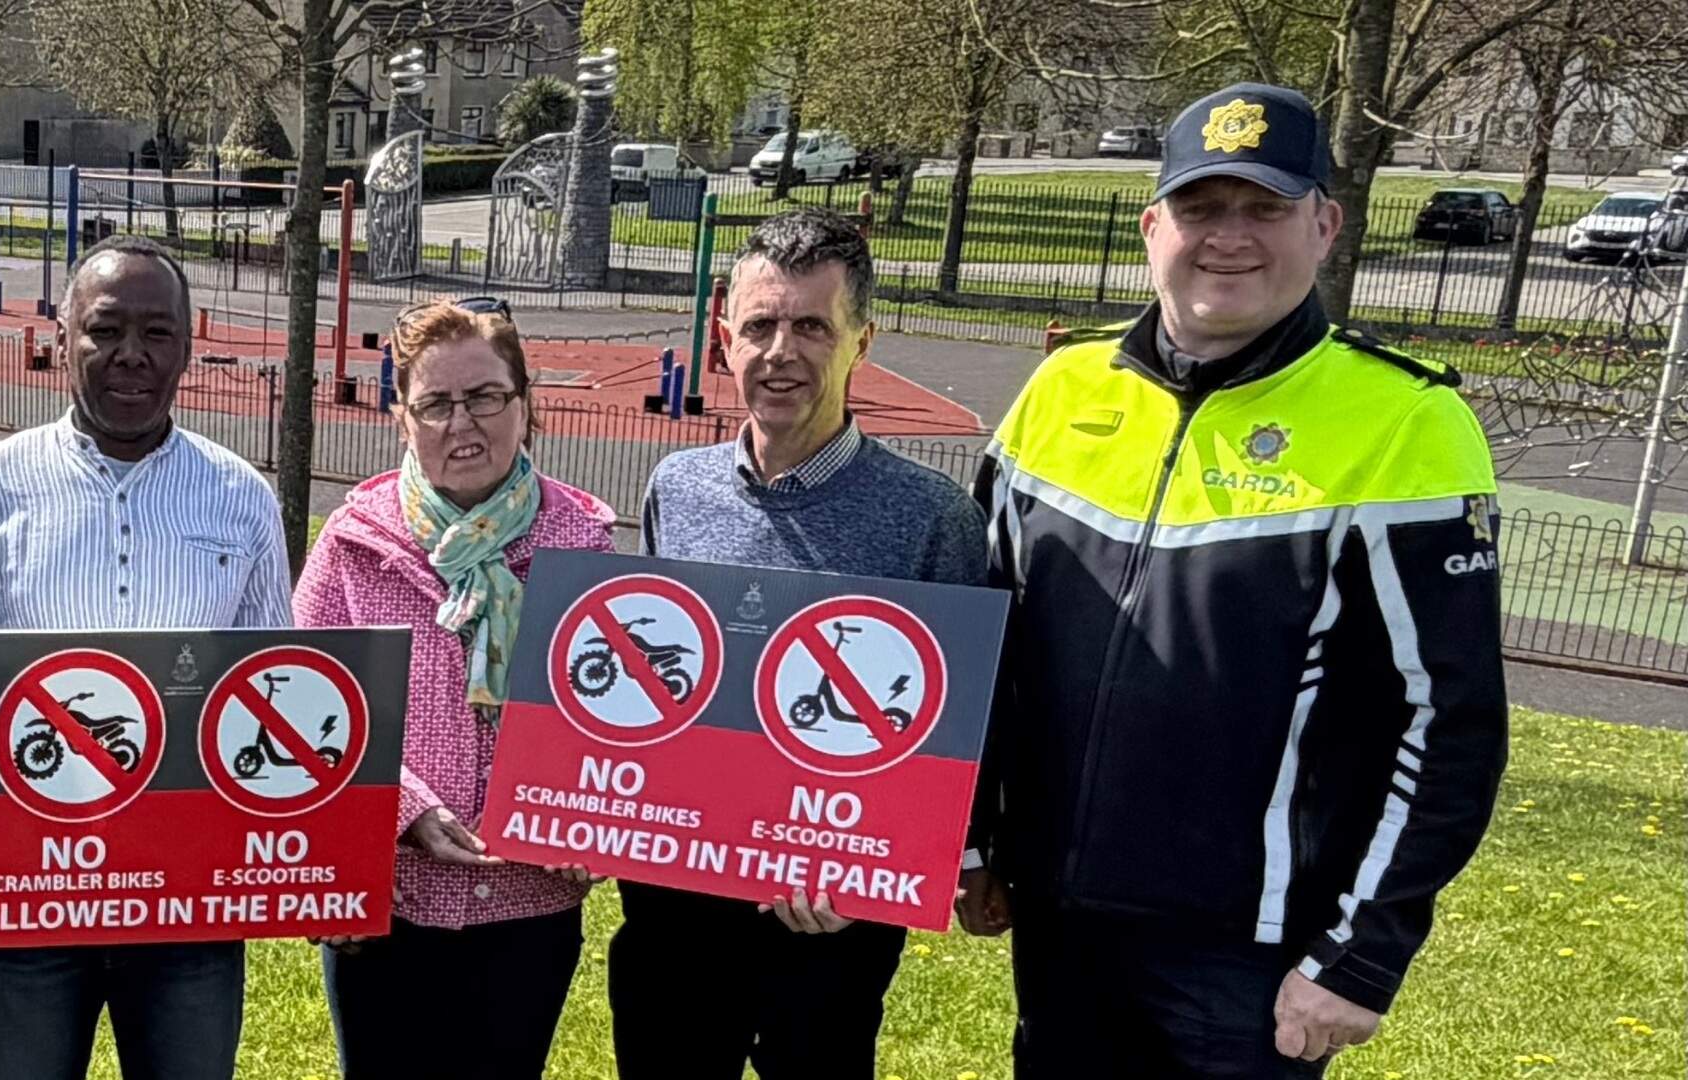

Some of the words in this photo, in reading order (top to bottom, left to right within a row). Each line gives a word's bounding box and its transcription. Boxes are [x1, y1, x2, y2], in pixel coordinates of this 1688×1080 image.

[1202, 468, 1295, 498] GARDA
[578, 755, 646, 794] NO
[514, 784, 637, 819] SCRAMBLER
[640, 804, 702, 828] BIKES
[788, 785, 862, 829] NO
[42, 835, 106, 870] NO
[245, 830, 309, 864] NO
[751, 819, 891, 857] E-SCOOTERS
[502, 810, 680, 863] ALLOWED
[686, 839, 729, 873] IN
[734, 845, 812, 887] THE
[816, 860, 927, 906] PARK
[107, 871, 165, 889] BIKES
[213, 866, 335, 886] E-SCOOTERS
[158, 897, 193, 925] IN
[201, 894, 268, 923] THE
[277, 891, 367, 921] PARK
